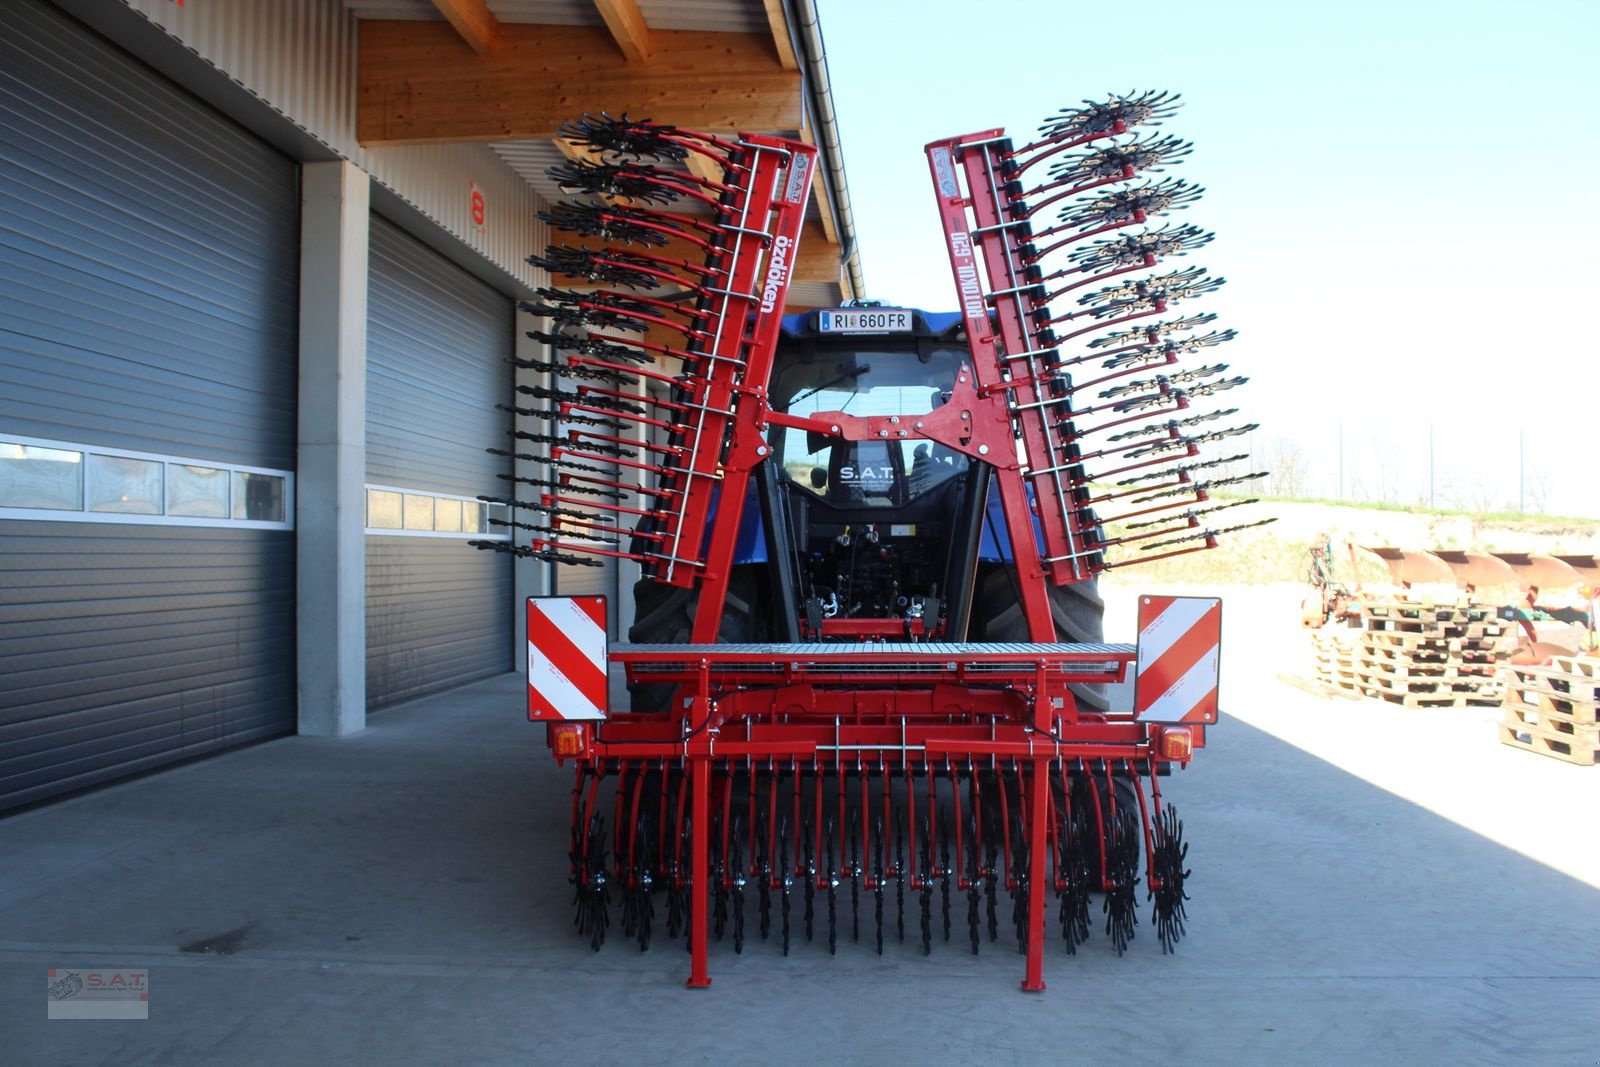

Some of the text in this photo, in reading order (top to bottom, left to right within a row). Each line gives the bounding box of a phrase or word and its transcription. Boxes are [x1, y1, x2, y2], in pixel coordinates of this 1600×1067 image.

[471, 191, 485, 225] 8
[760, 235, 793, 313] özdöken
[835, 314, 848, 328] RI
[840, 466, 894, 479] S.A.T.
